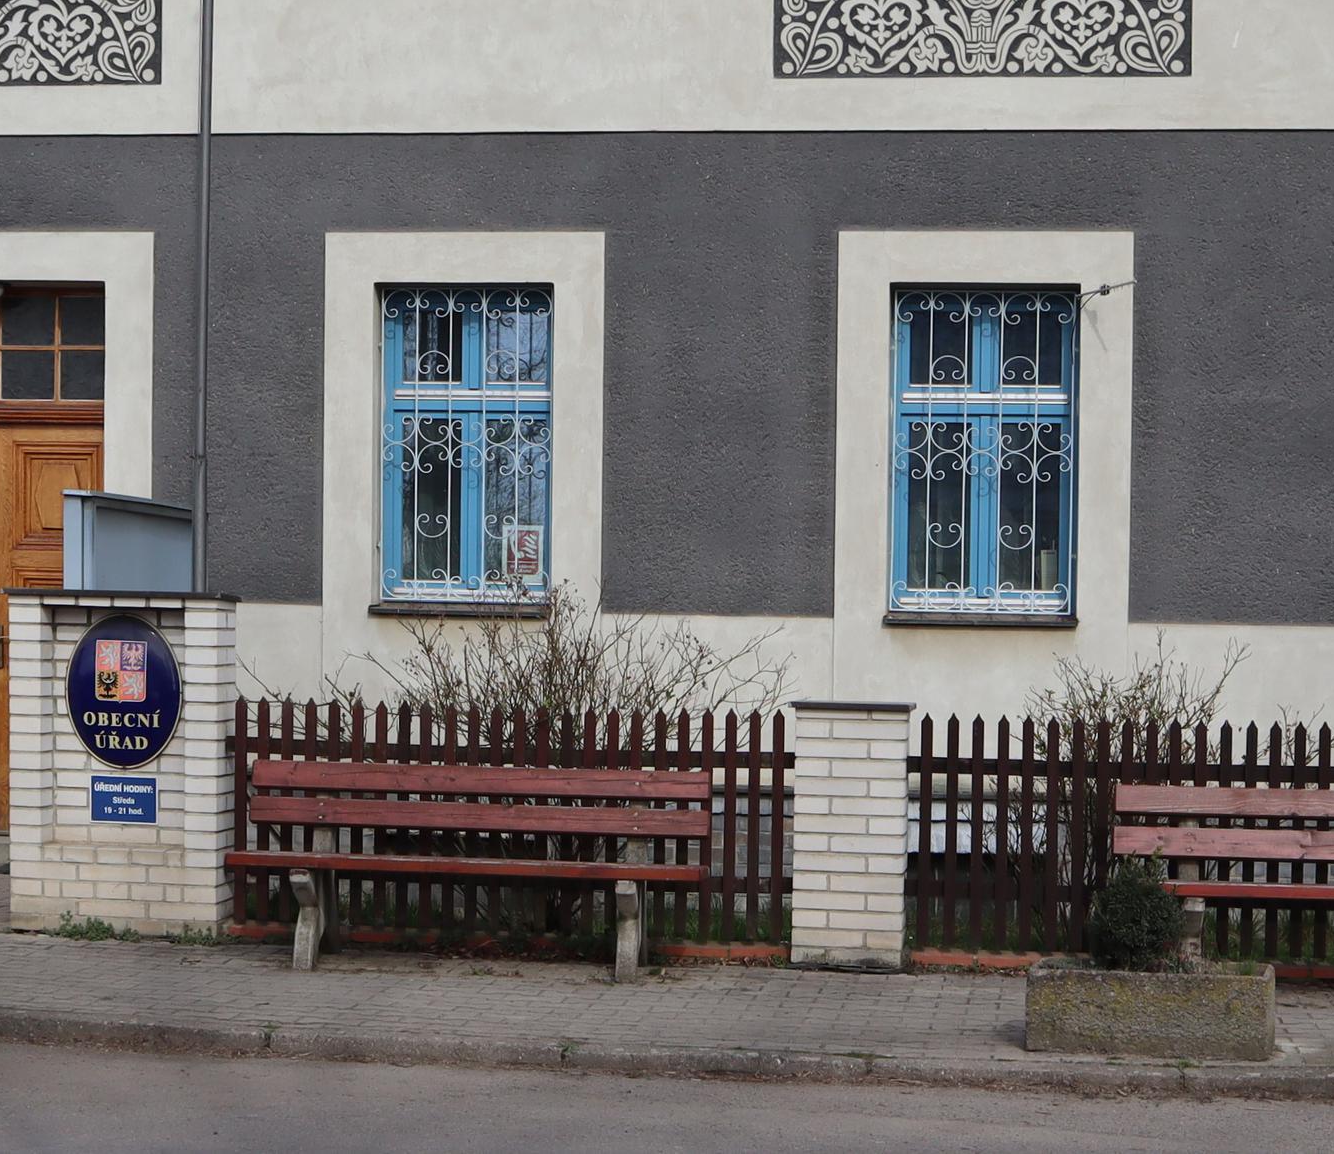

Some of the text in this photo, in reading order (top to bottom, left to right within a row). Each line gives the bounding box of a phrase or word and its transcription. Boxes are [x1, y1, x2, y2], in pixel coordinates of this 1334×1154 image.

[83, 709, 160, 728] OBECNÍ
[94, 730, 148, 750] ÚŘAD
[94, 781, 154, 794] ÚŘEDNÍ HODINY:
[112, 796, 135, 804] Středa
[128, 807, 144, 815] hod.
